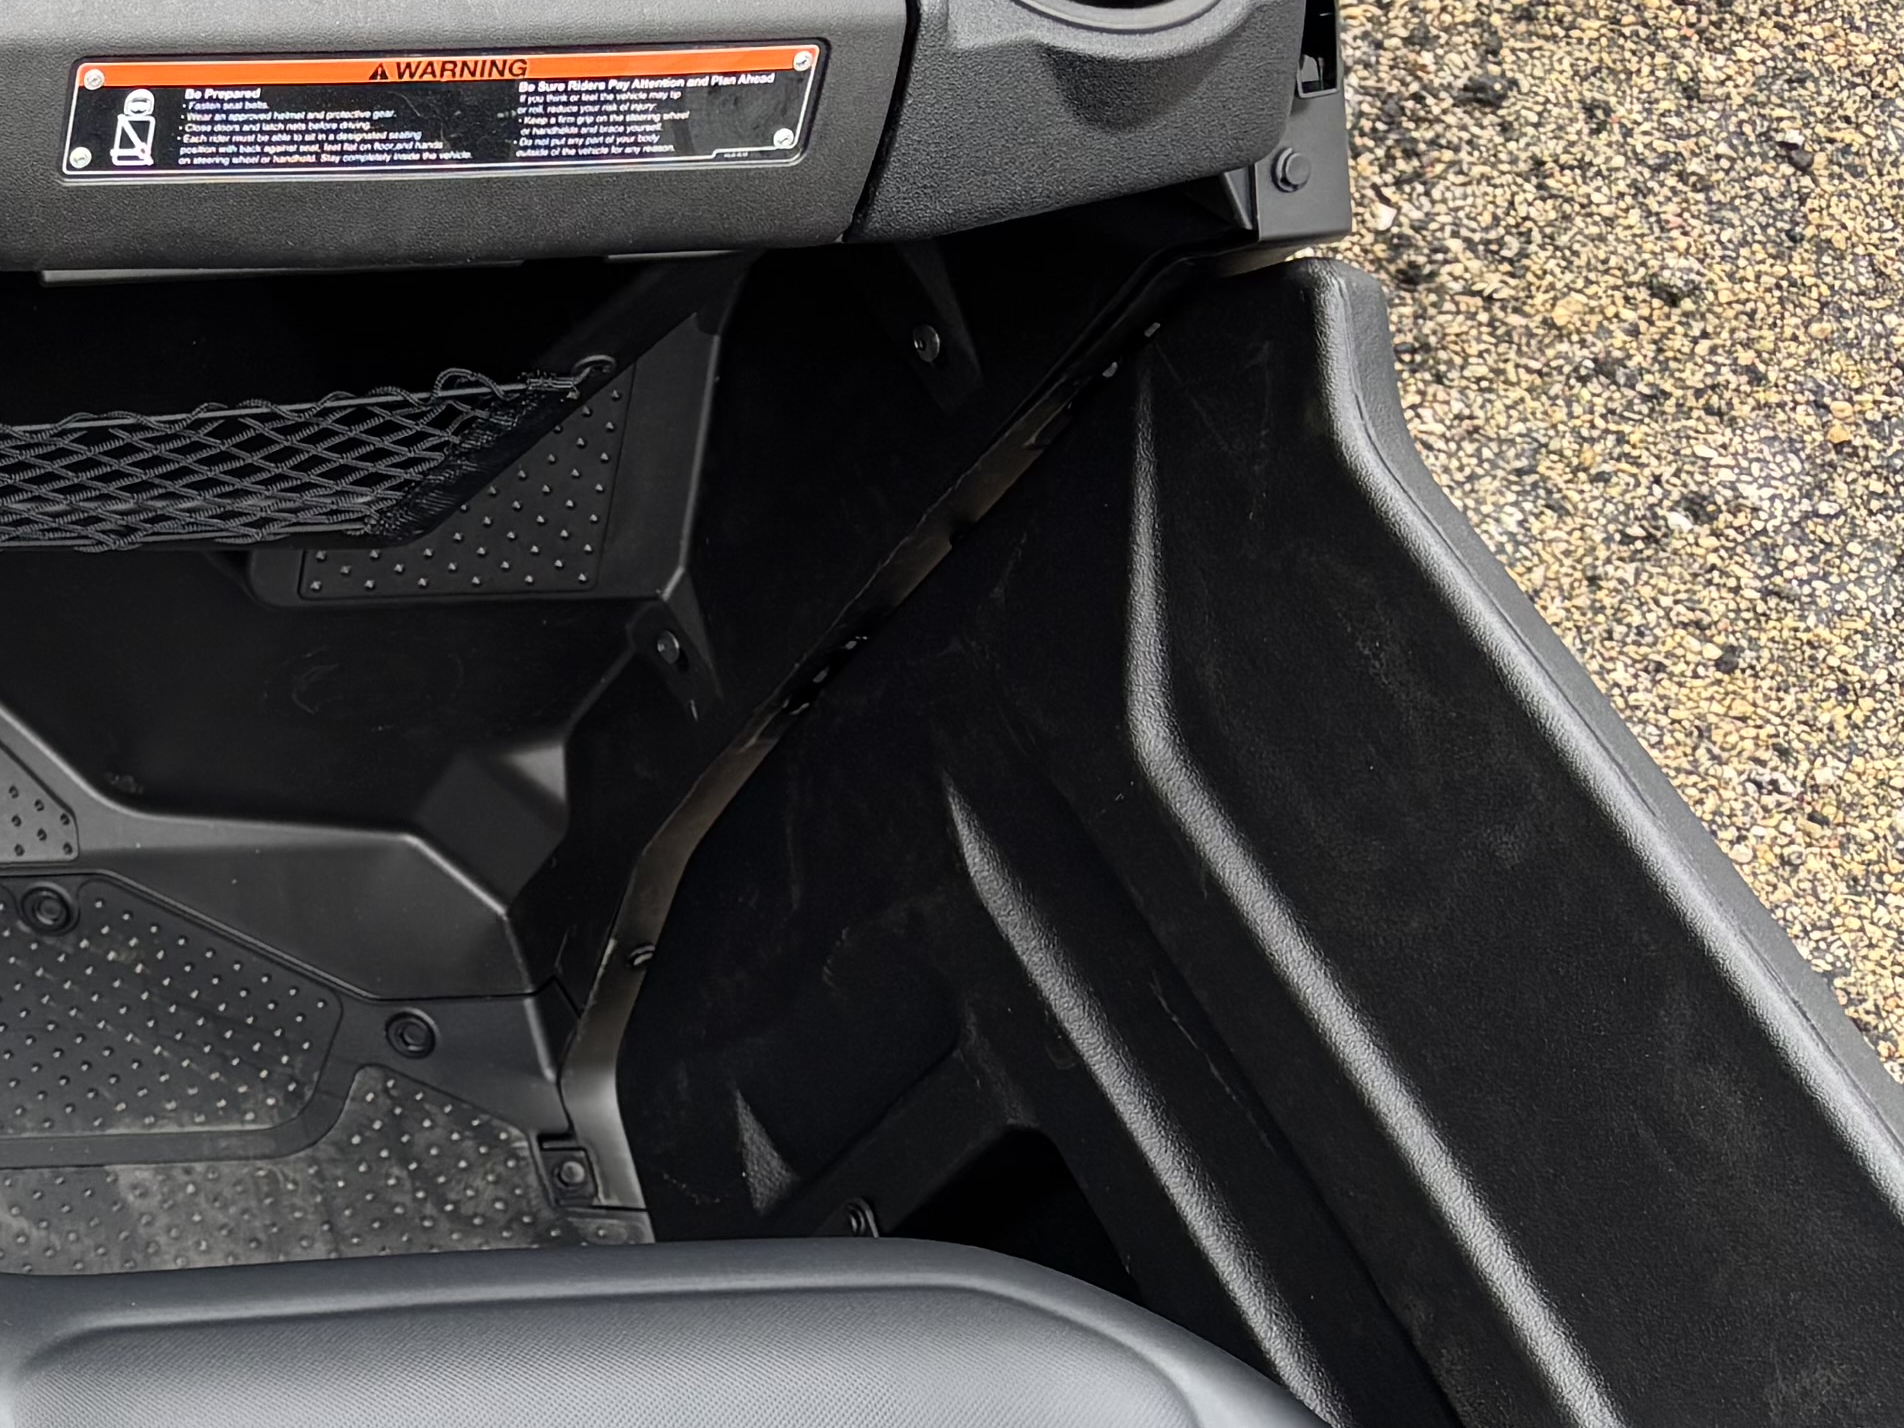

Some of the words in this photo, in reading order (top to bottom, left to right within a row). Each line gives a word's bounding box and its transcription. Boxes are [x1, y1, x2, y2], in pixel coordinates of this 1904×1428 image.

[394, 58, 529, 81] WARNING
[518, 81, 535, 92] Be
[537, 80, 565, 92] Sure
[567, 79, 605, 91] Riders
[607, 78, 630, 91] Pay
[630, 76, 684, 89] Attention
[686, 75, 709, 87] and
[710, 74, 736, 85] Plan
[737, 72, 775, 84] Ahead
[184, 88, 201, 99] Be
[204, 87, 260, 100] Prepared
